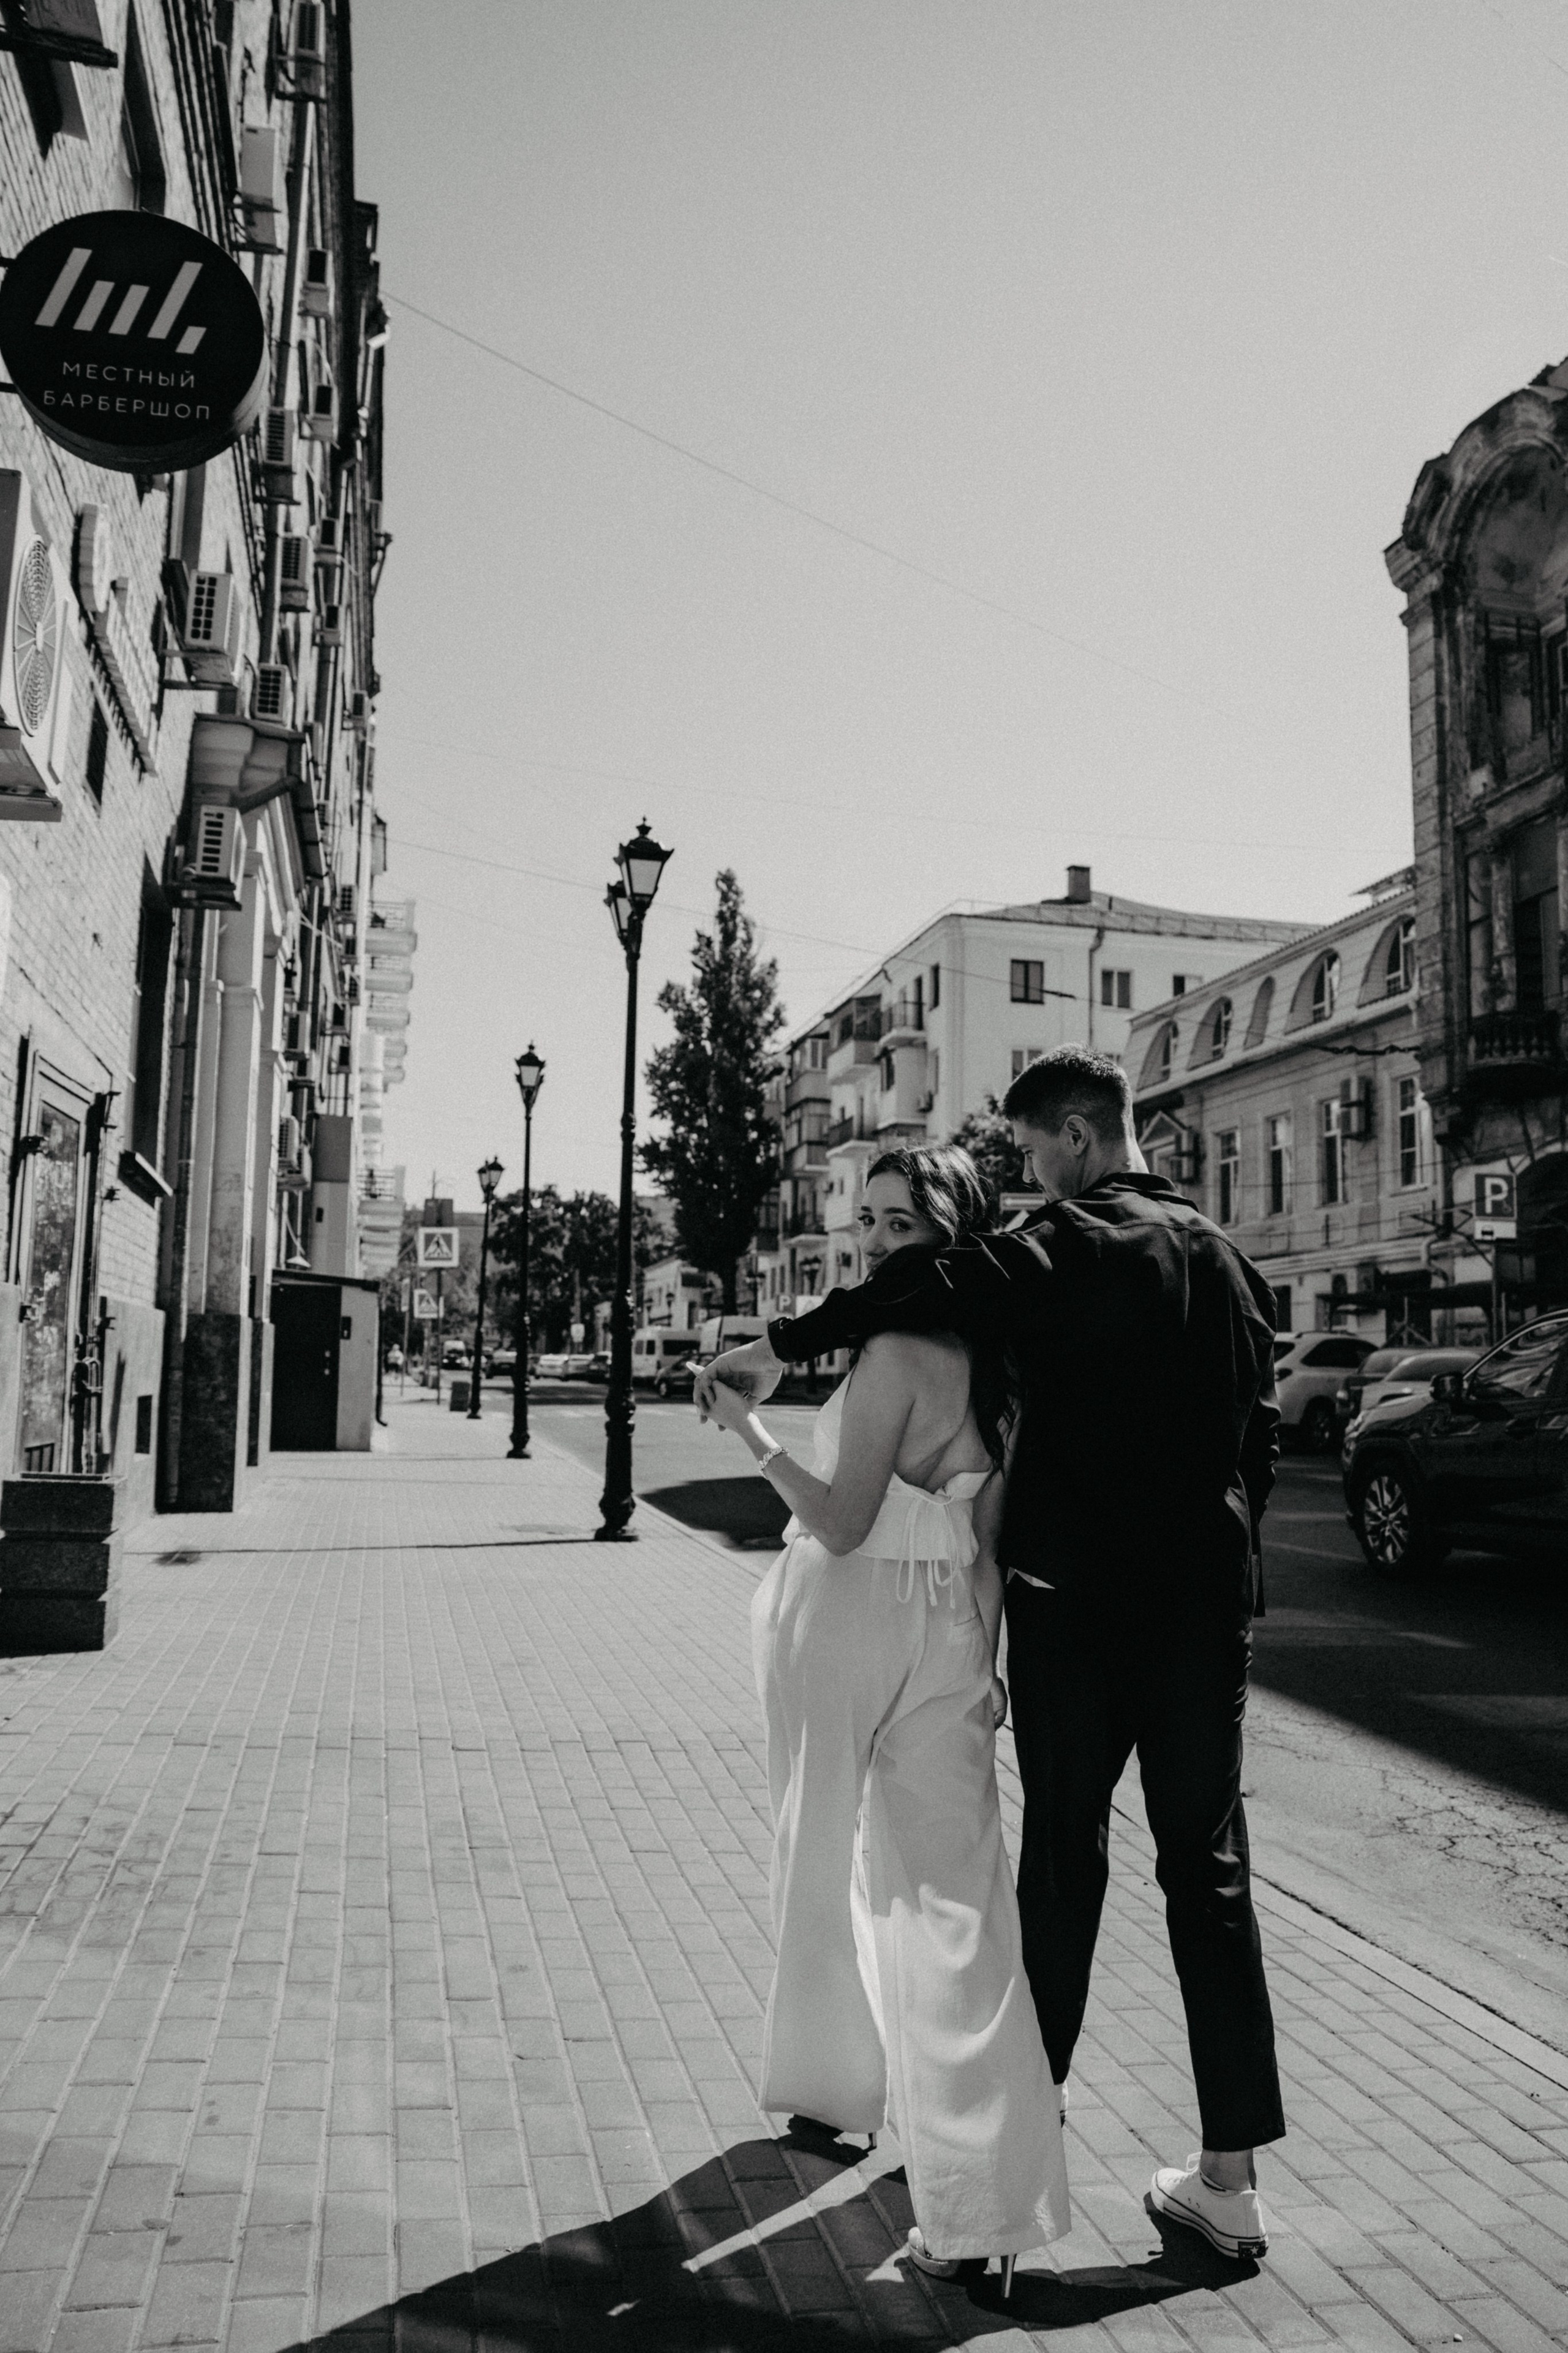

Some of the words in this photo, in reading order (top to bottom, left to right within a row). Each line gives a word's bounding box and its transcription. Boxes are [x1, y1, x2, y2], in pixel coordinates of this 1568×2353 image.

[62, 361, 196, 388] МЕСТНЫЙ
[43, 390, 211, 420] БАРБЕРШОП
[1484, 1177, 1509, 1215] P
